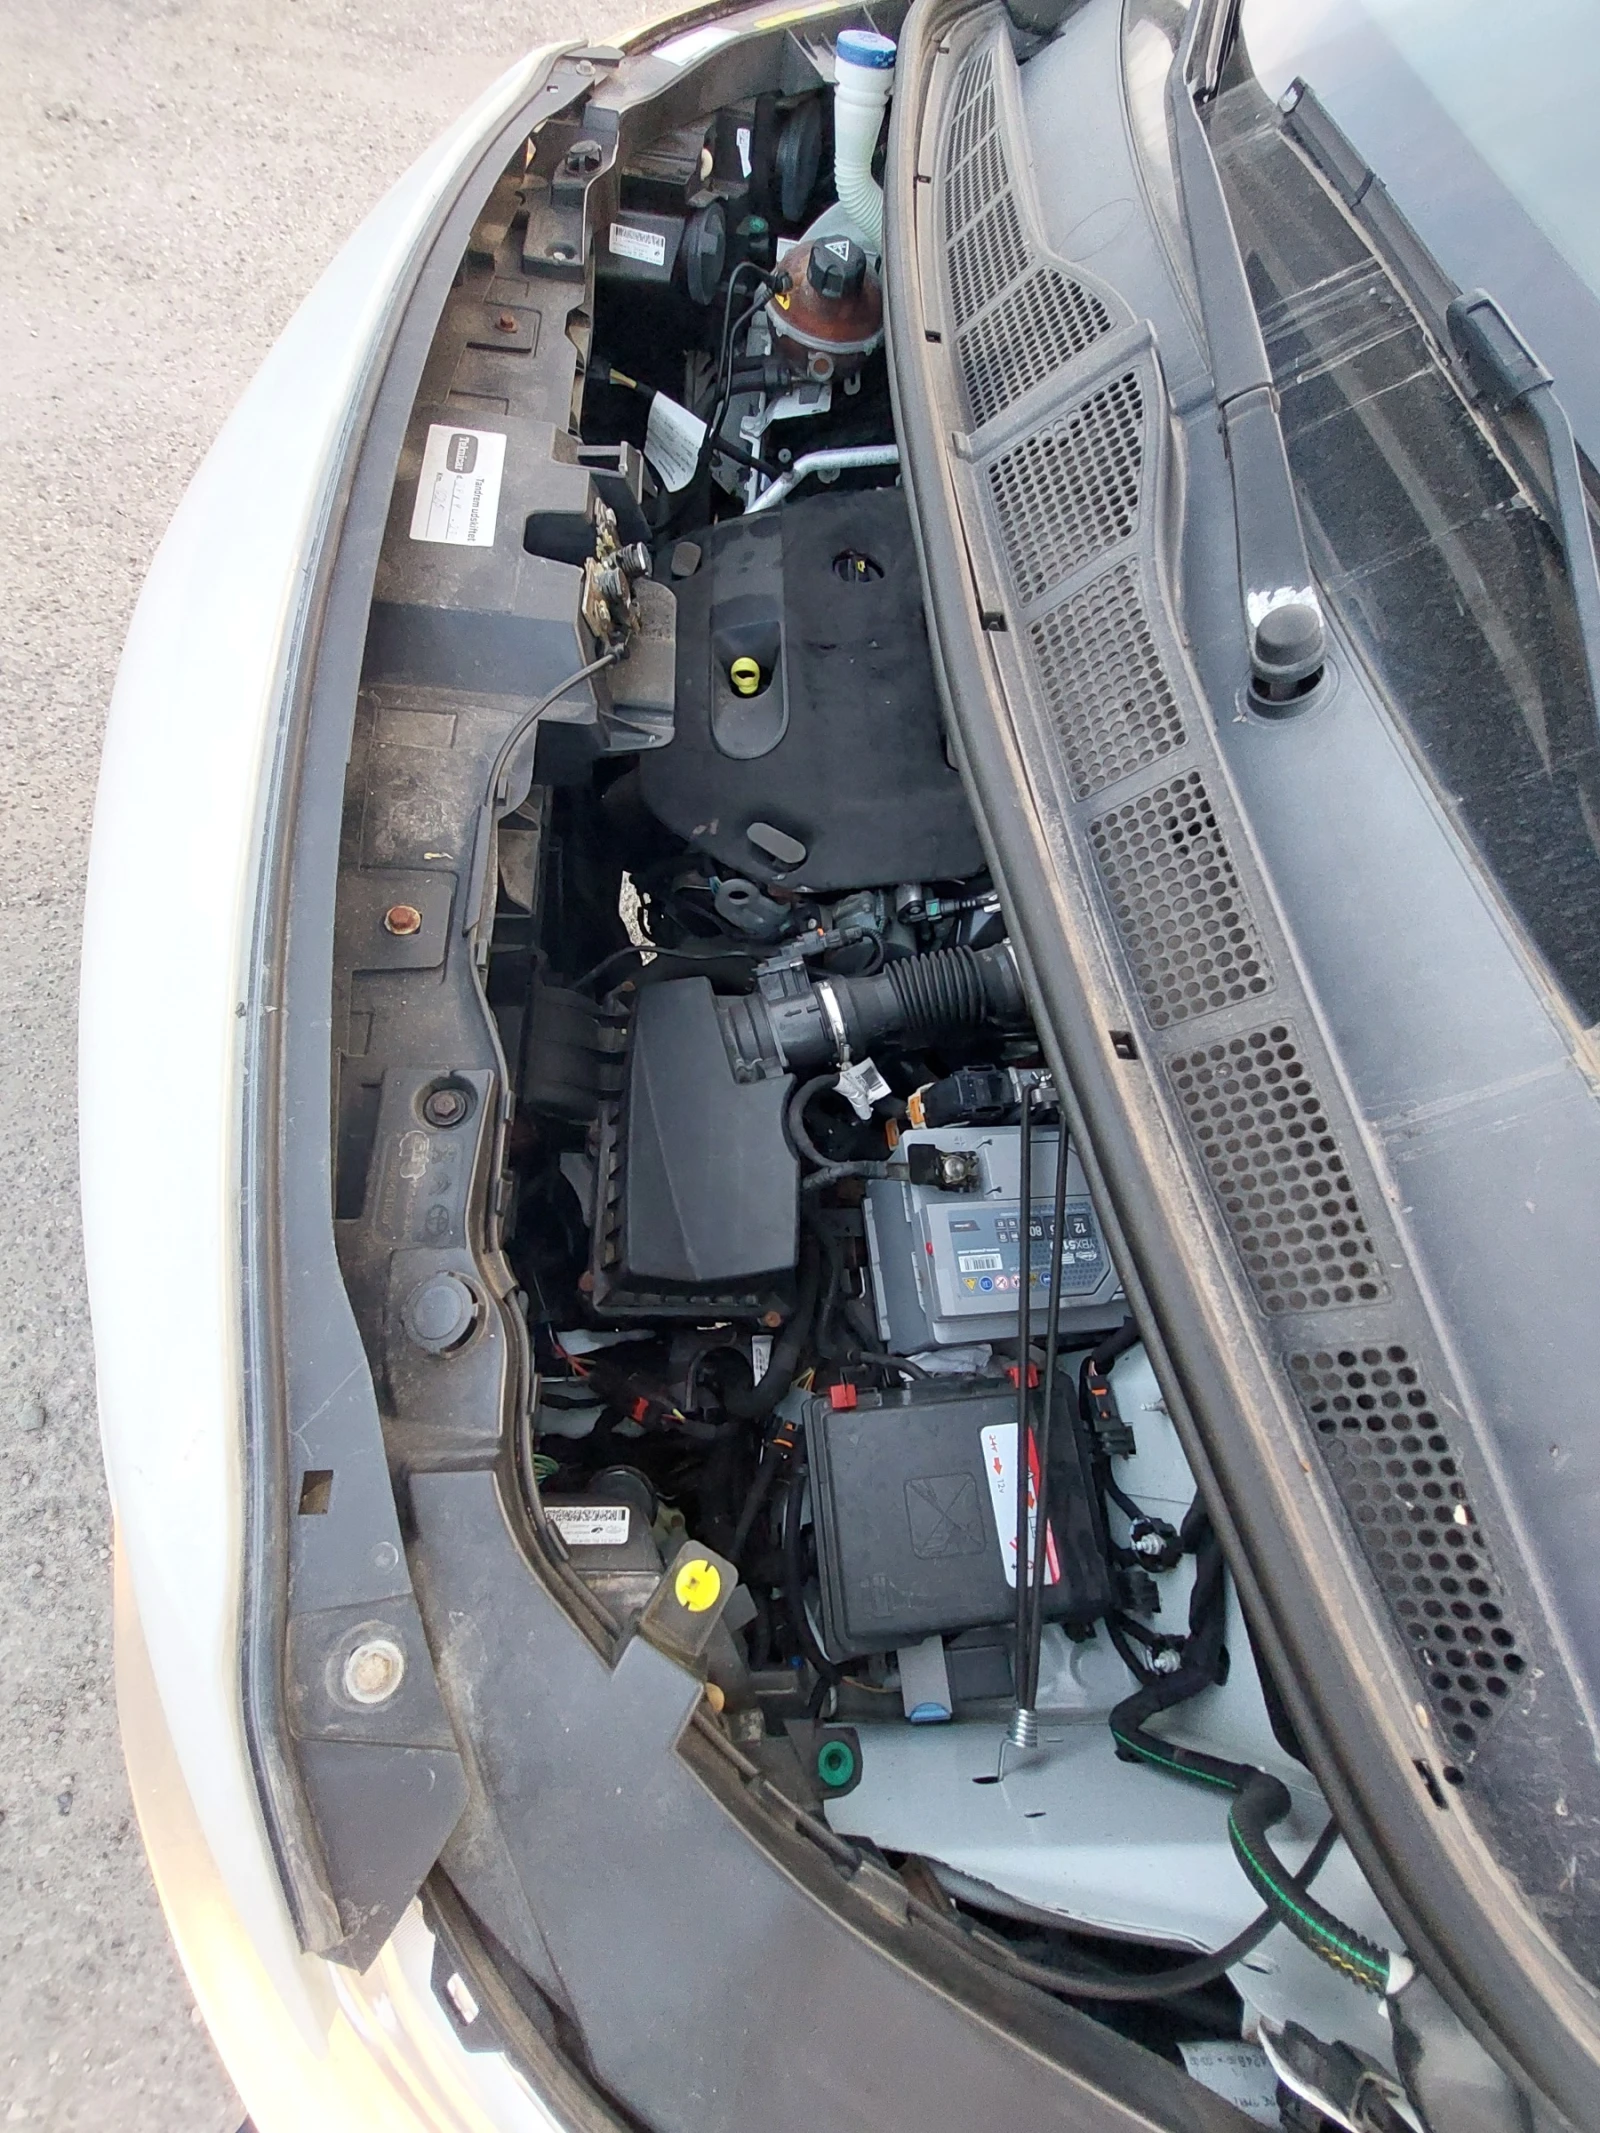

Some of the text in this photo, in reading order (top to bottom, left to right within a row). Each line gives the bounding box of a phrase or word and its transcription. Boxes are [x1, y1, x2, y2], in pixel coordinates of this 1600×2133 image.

[454, 436, 470, 472] Teknicar
[467, 478, 485, 542] Tandrem udskiftet
[1074, 1222, 1087, 1234] 12
[996, 1478, 1005, 1494] 12v
